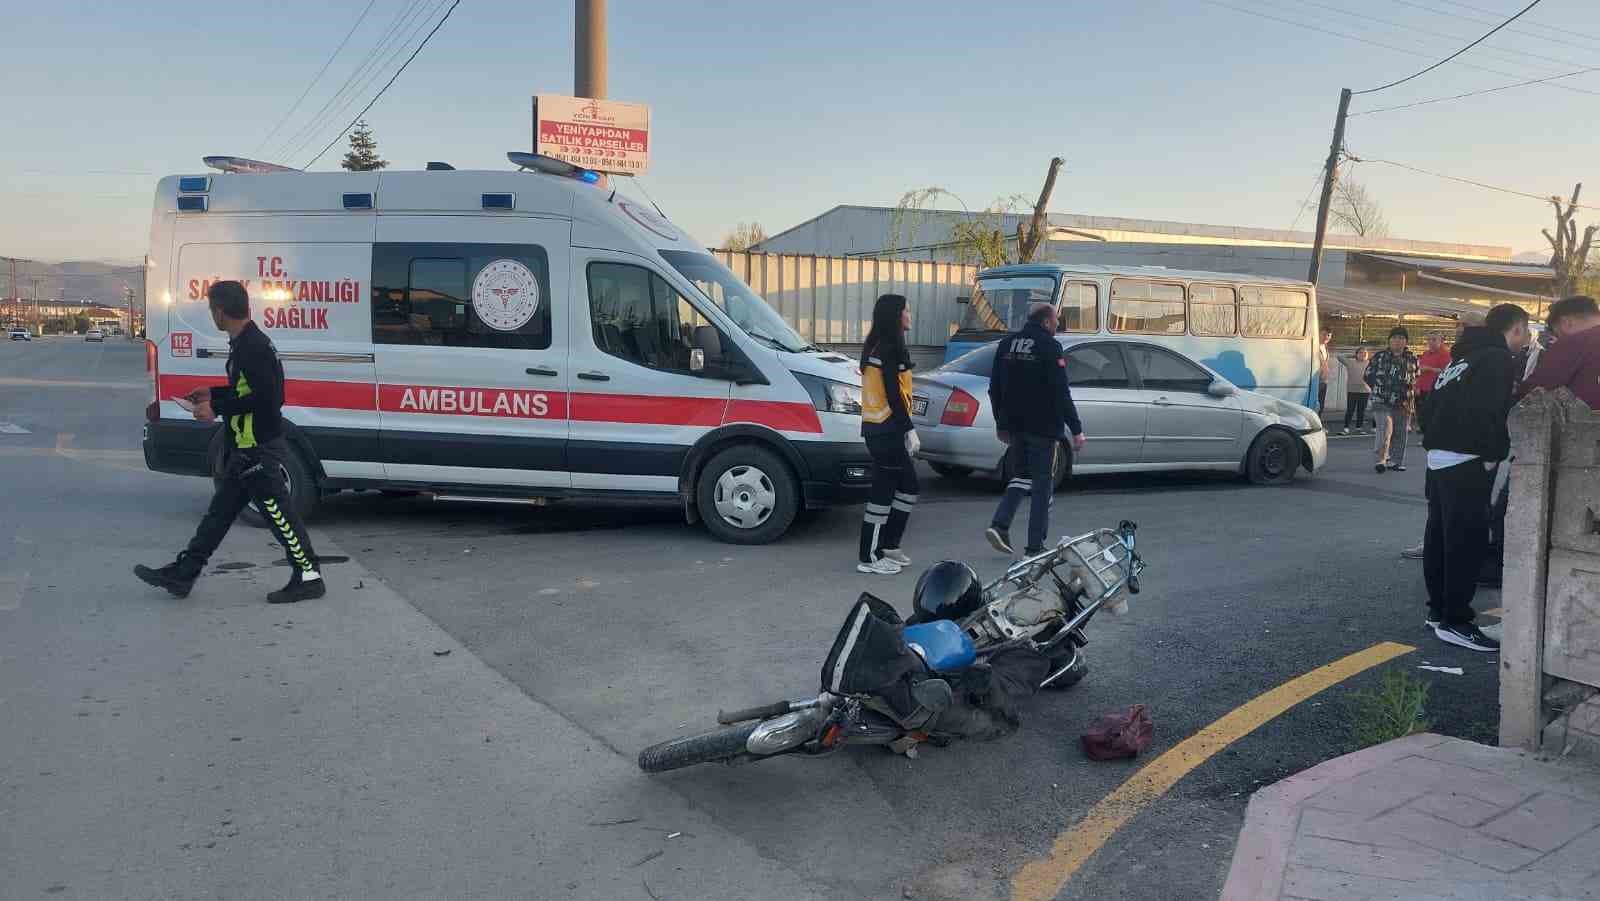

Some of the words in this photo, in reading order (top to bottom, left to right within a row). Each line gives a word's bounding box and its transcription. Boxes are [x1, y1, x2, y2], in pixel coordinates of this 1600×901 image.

[541, 133, 583, 146] SATILIK
[585, 138, 644, 152] PARSELLER
[256, 256, 288, 278] T.C.
[263, 304, 329, 330] SAĞLIK
[174, 335, 189, 348] 112
[1009, 338, 1035, 353] 112
[400, 388, 549, 416] AMBULANS
